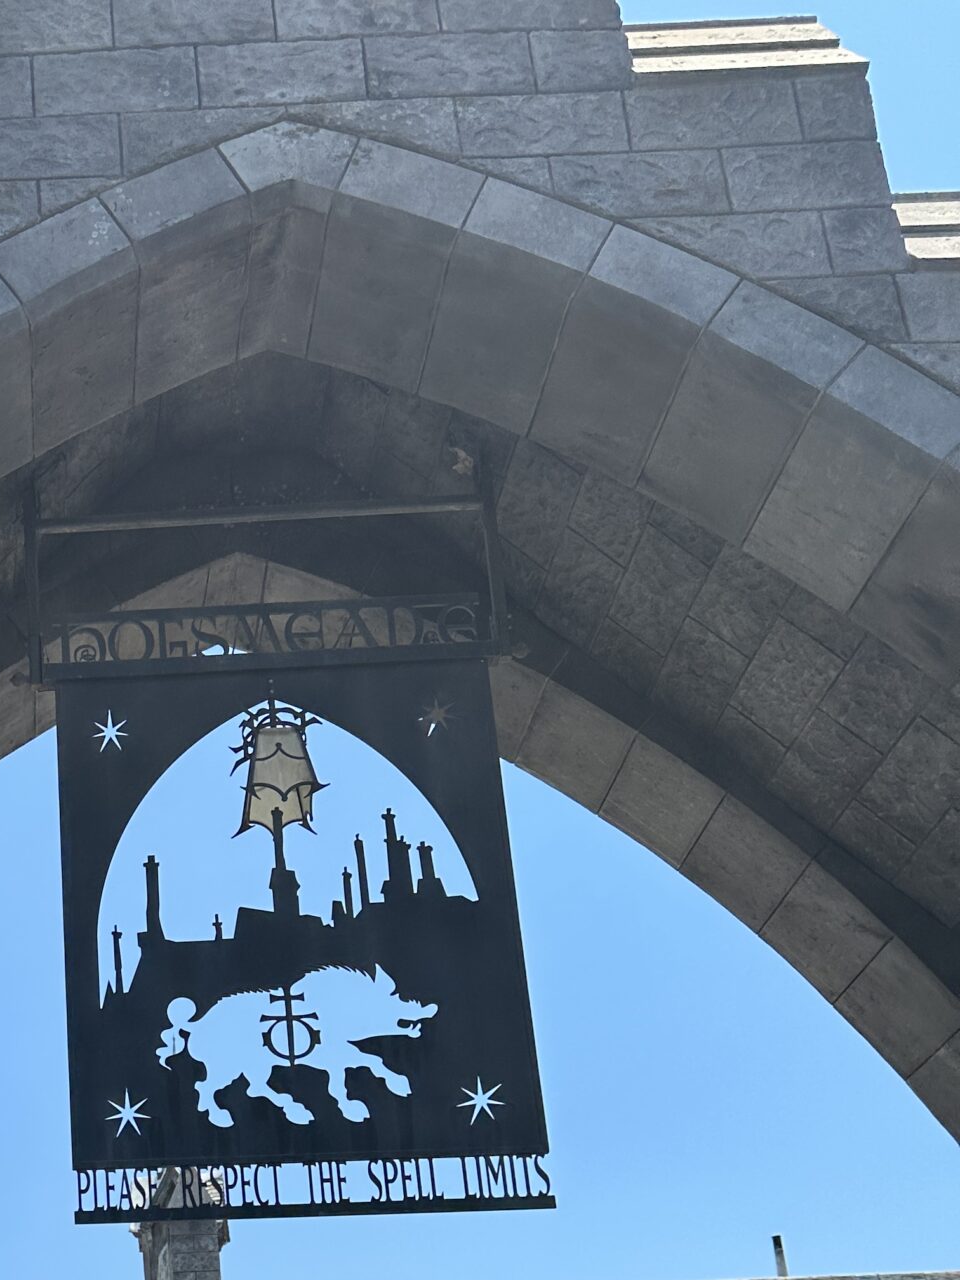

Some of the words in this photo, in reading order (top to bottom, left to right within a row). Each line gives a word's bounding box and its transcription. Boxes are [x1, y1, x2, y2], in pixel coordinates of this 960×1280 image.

[76, 1168, 161, 1212] PLEASE
[180, 1164, 282, 1208] RESPECT
[303, 1160, 349, 1205] THE
[368, 1157, 444, 1202] SPELL
[462, 1154, 551, 1199] LIMITS
